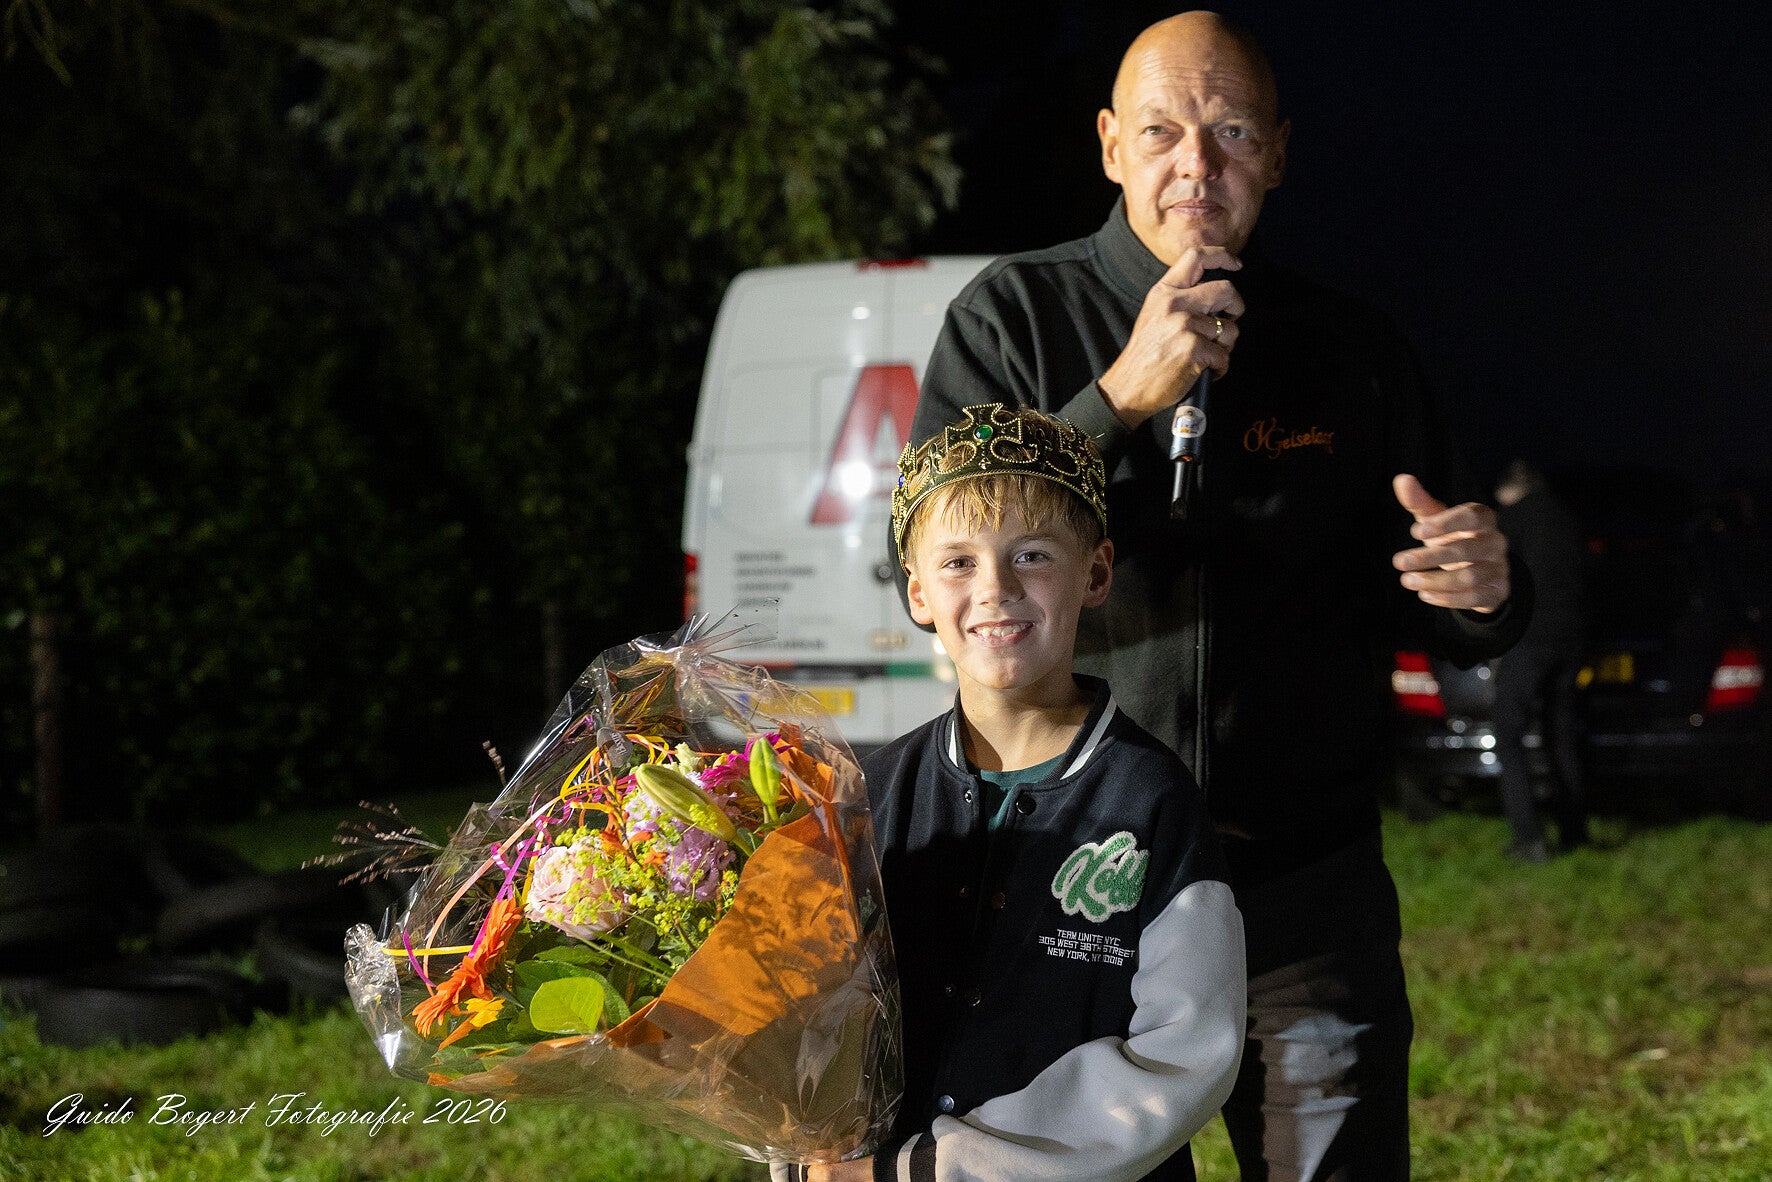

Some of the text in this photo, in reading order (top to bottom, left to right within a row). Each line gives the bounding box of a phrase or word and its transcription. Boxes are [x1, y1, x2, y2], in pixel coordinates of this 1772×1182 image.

[1038, 935, 1136, 959] 305 WEST 38TH STREET
[1057, 929, 1122, 948] TEAM UNITE NYC
[1047, 947, 1066, 958] NEW
[1066, 950, 1091, 964] YORK,
[1091, 953, 1102, 963] NY
